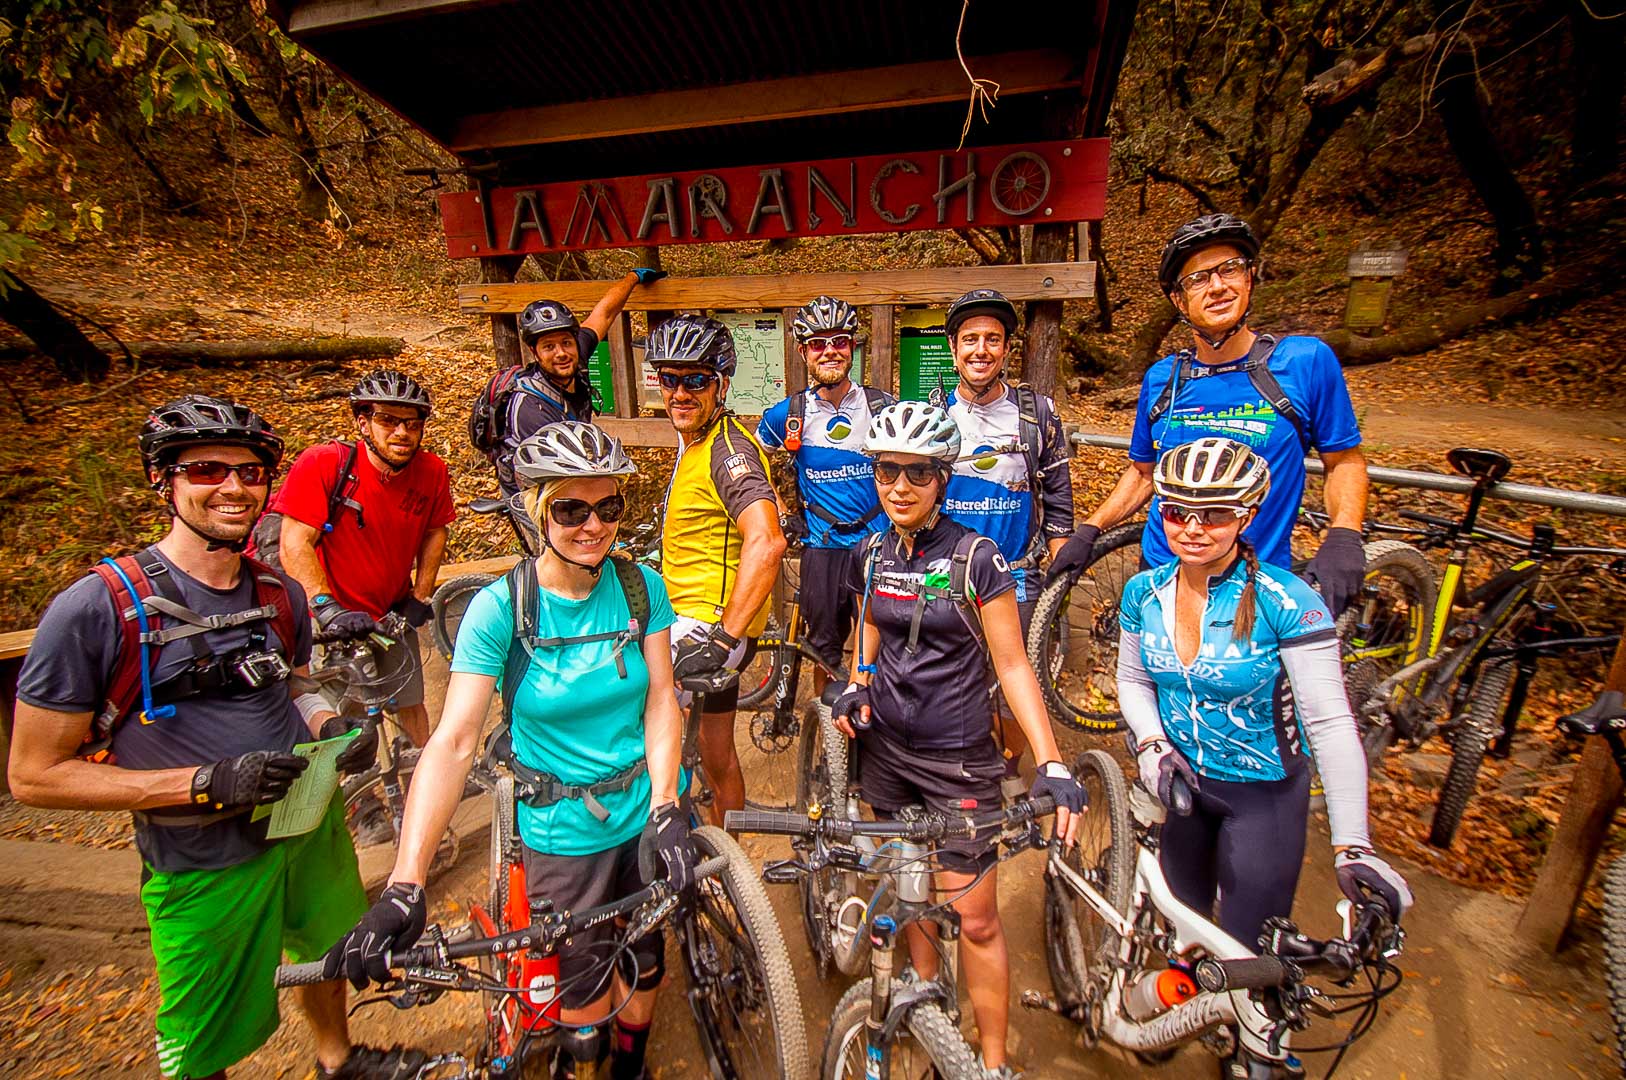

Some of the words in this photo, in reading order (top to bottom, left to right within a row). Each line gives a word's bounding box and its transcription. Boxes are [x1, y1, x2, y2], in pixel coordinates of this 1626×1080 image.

[805, 462, 875, 480] SacredRide
[945, 496, 1022, 511] SacredRides
[1075, 715, 1117, 729] MAXXIS
